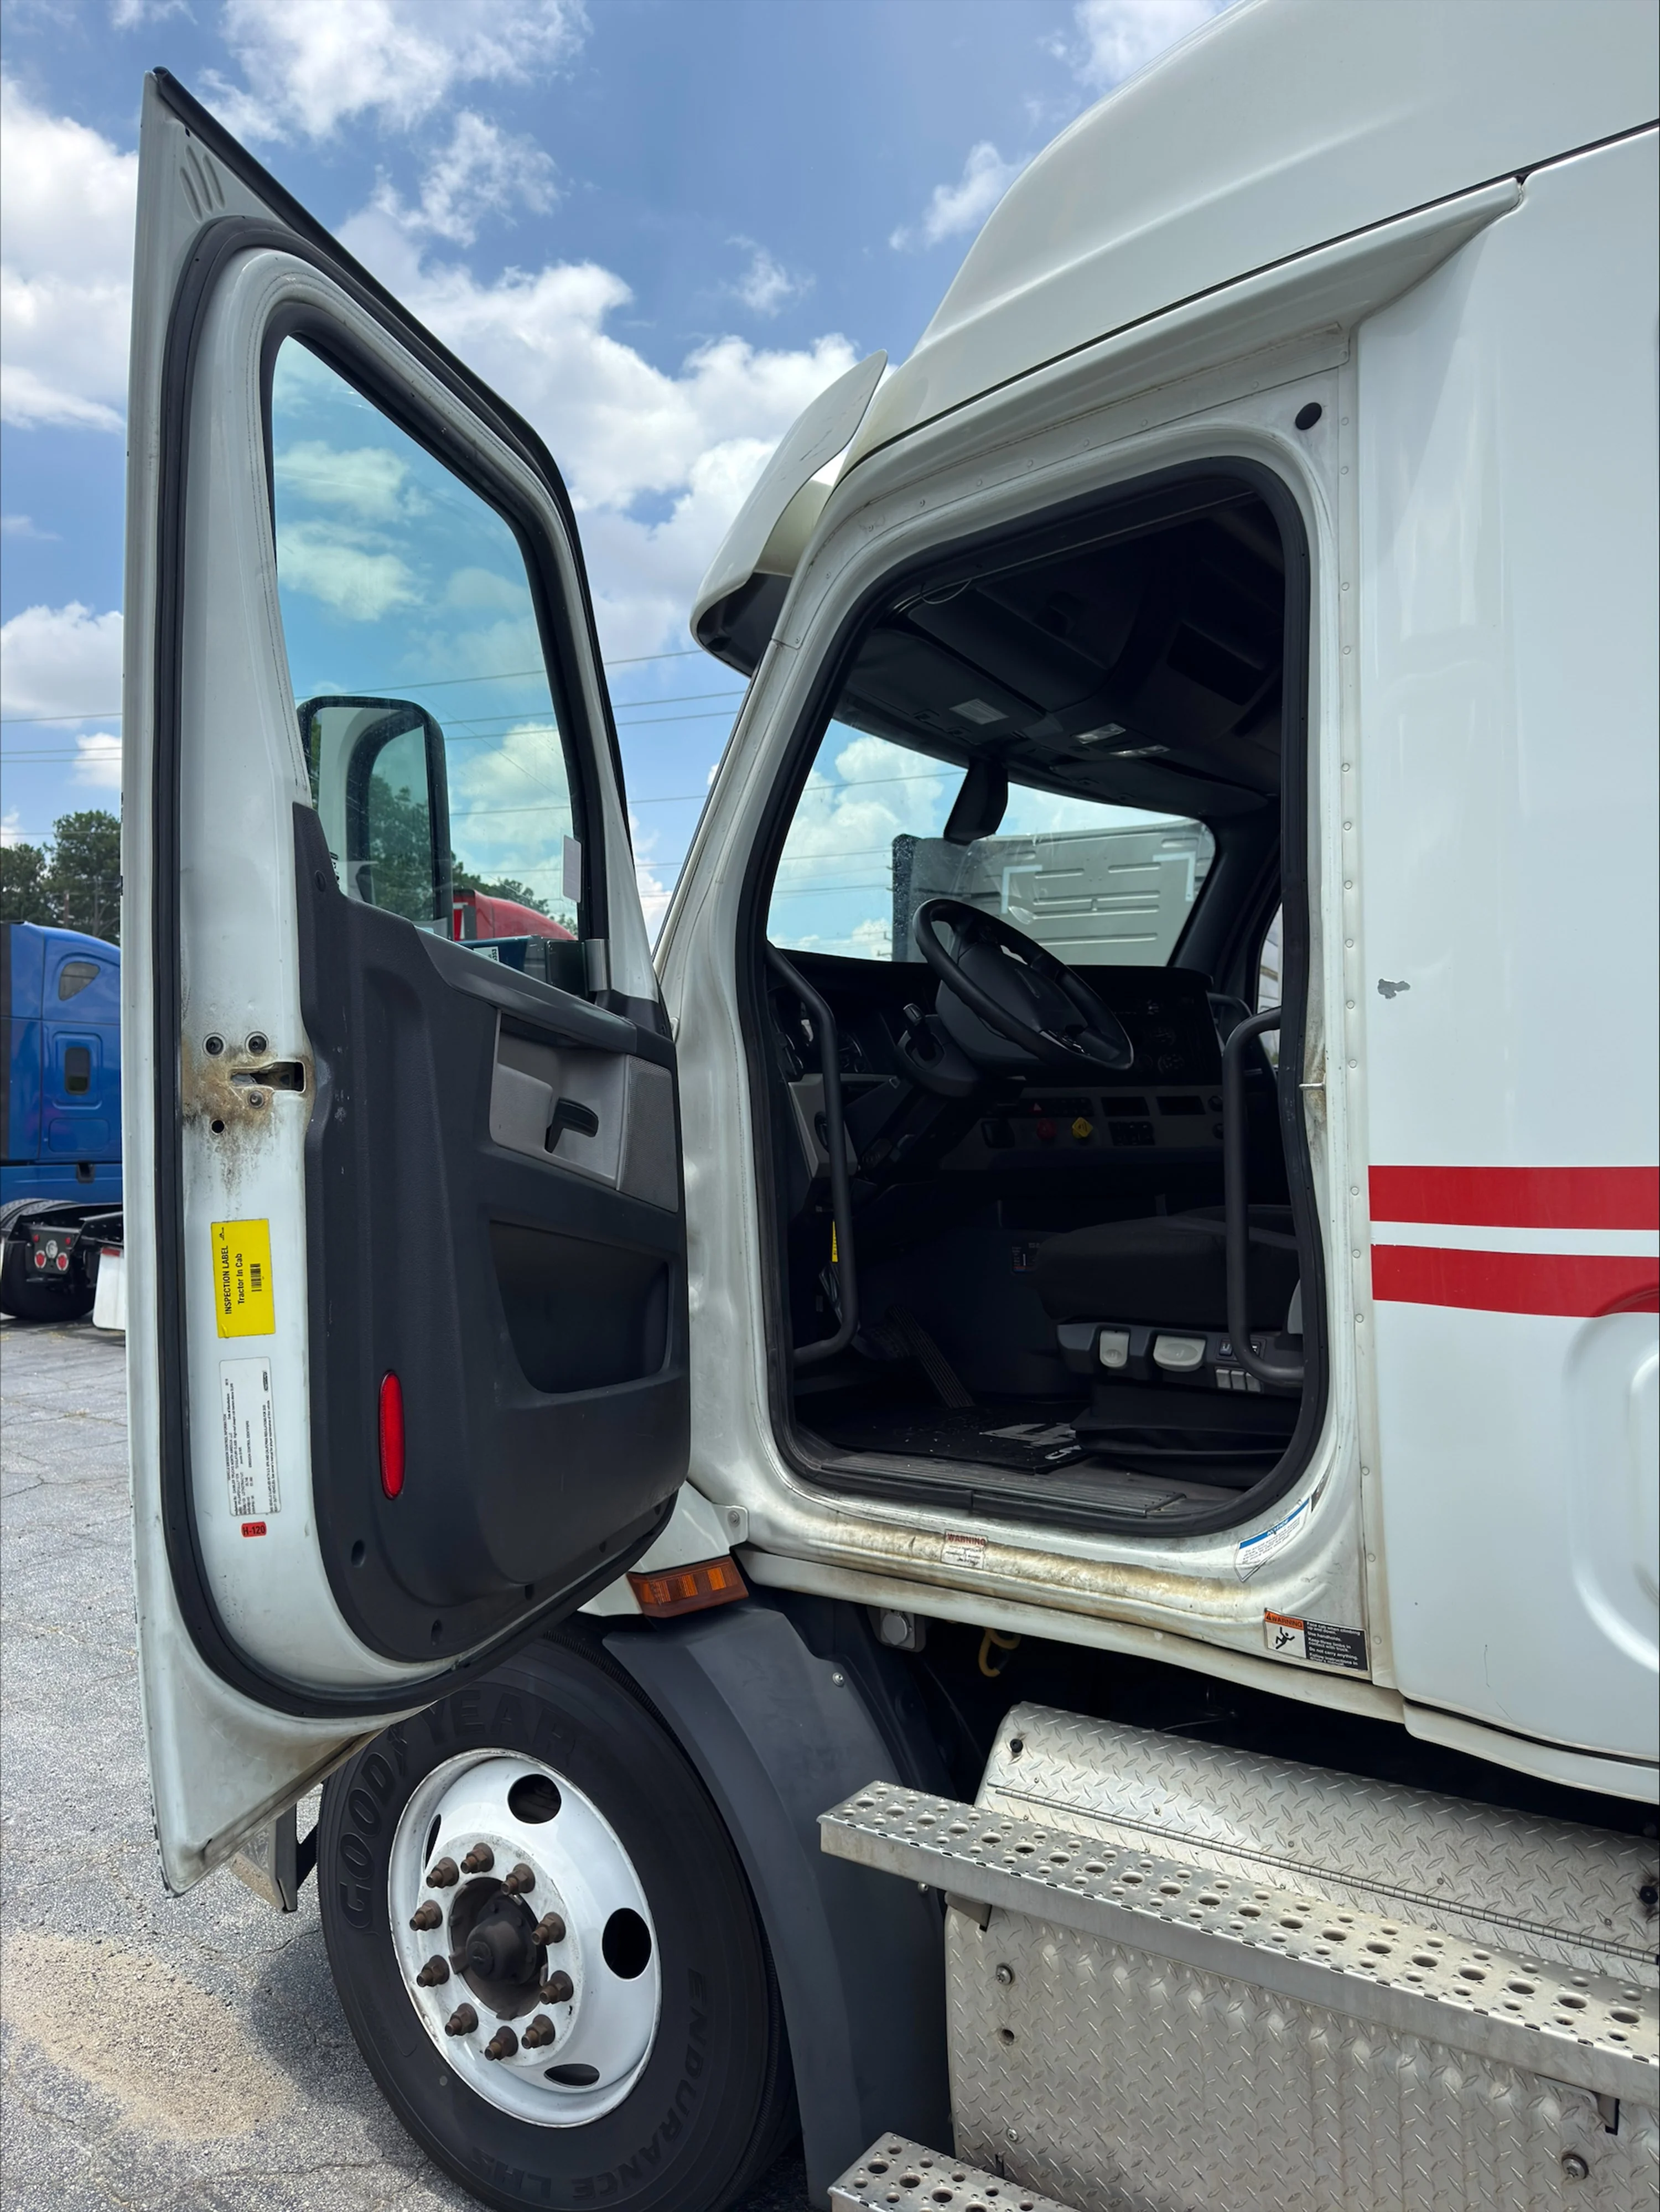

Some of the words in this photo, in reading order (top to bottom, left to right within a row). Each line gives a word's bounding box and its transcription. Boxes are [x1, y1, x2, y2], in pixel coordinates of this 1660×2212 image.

[222, 1271, 232, 1314] INSPECTION
[243, 1525, 266, 1536] H-120
[947, 1533, 986, 1546] WARNING
[1272, 1616, 1303, 1628] WARNING
[572, 1968, 708, 2200] ENDURANCE
